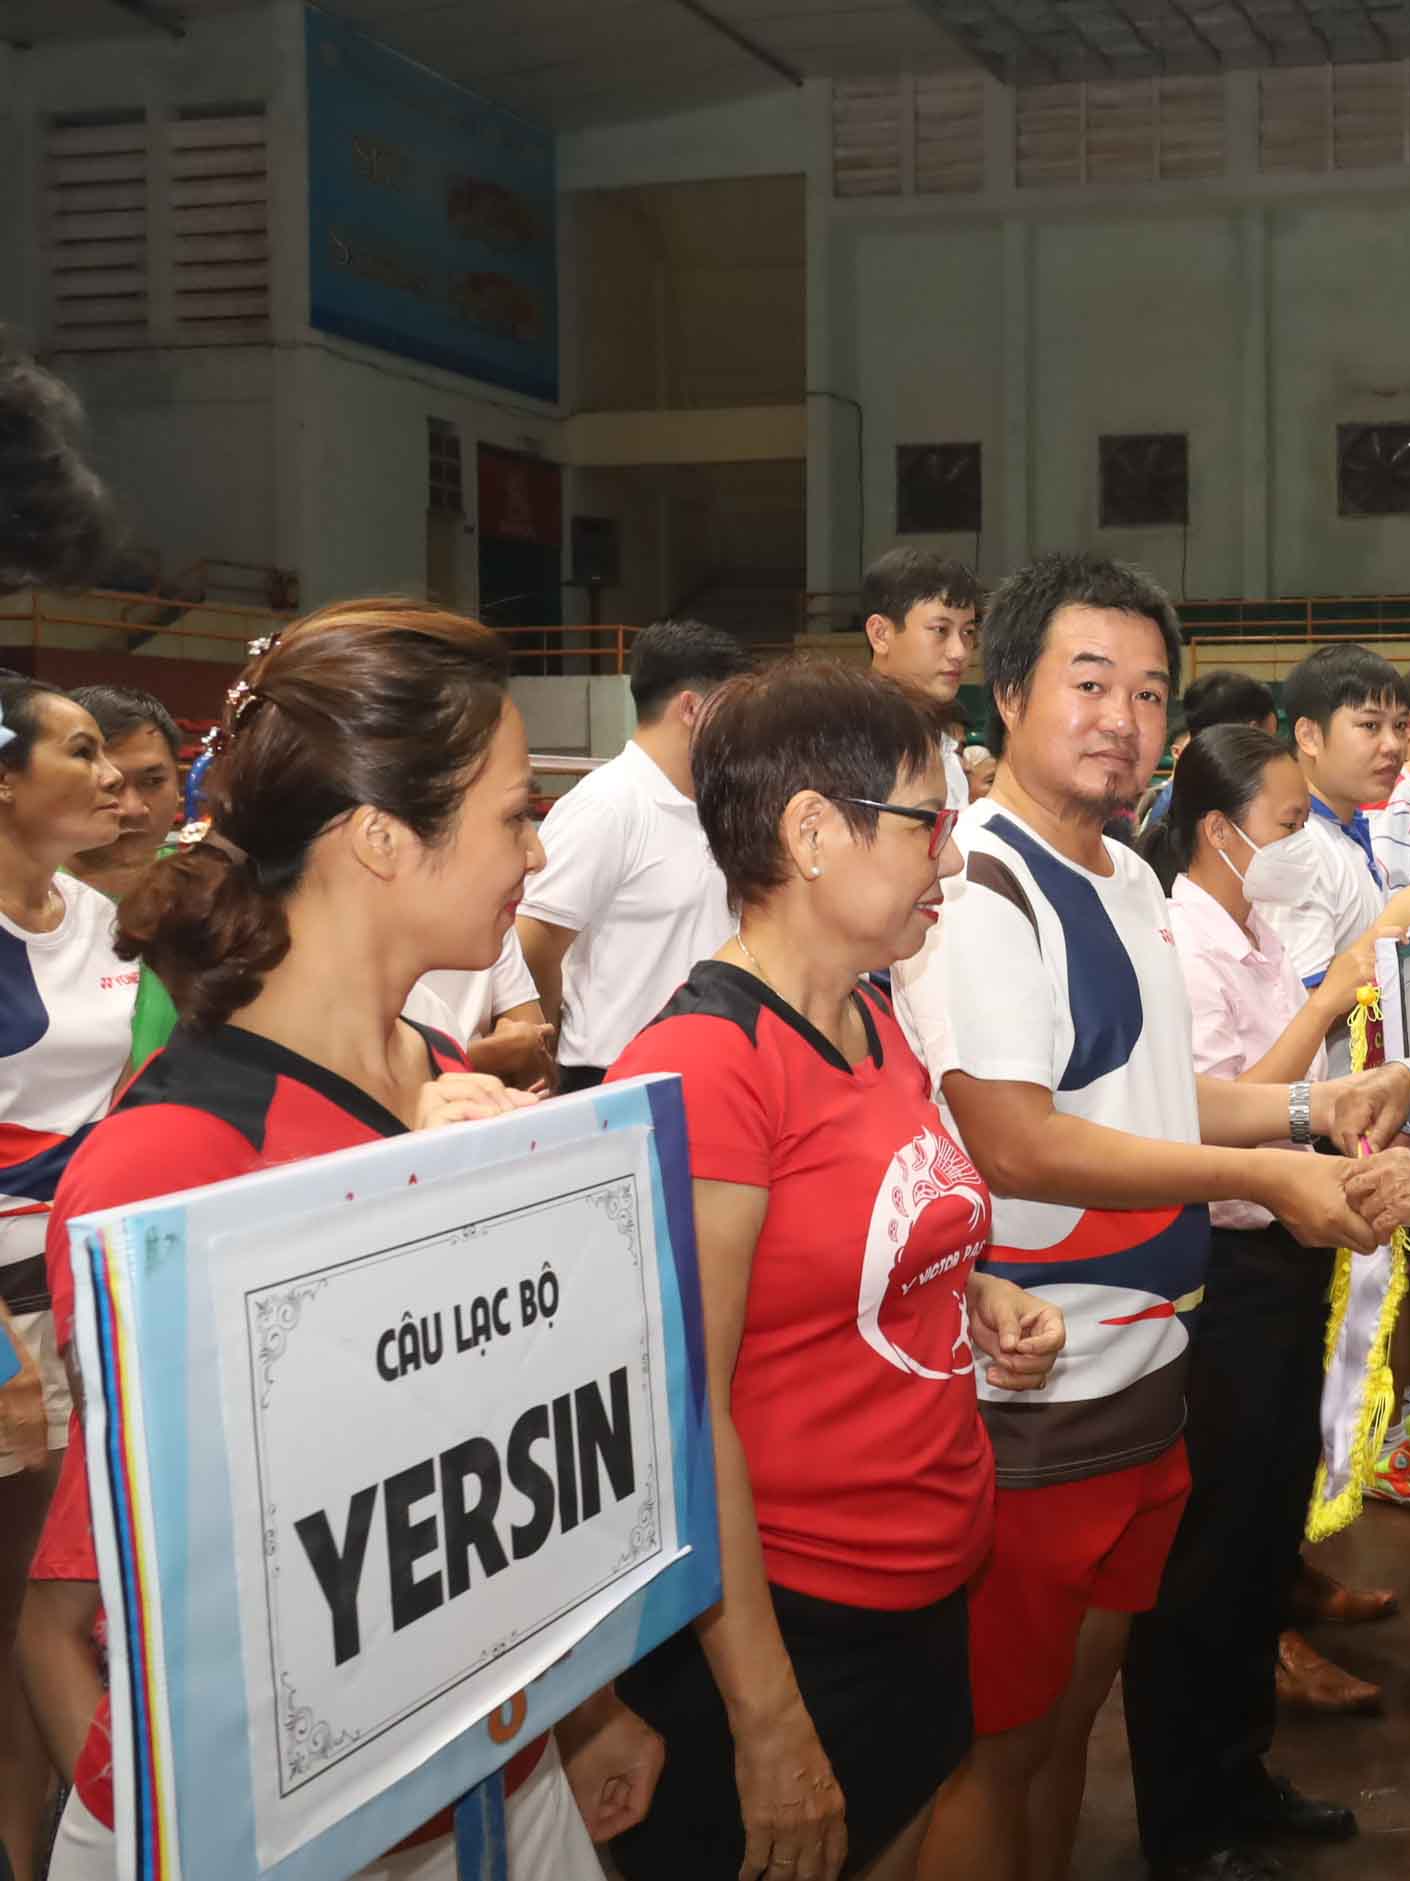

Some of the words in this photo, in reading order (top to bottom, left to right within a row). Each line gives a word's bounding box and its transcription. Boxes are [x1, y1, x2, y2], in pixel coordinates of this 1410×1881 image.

[376, 1310, 443, 1382] CÂU
[455, 1287, 511, 1357] LẠC
[519, 1261, 559, 1329] BỘ
[919, 1250, 960, 1285] VICTOR
[294, 1366, 636, 1667] YERSIN
